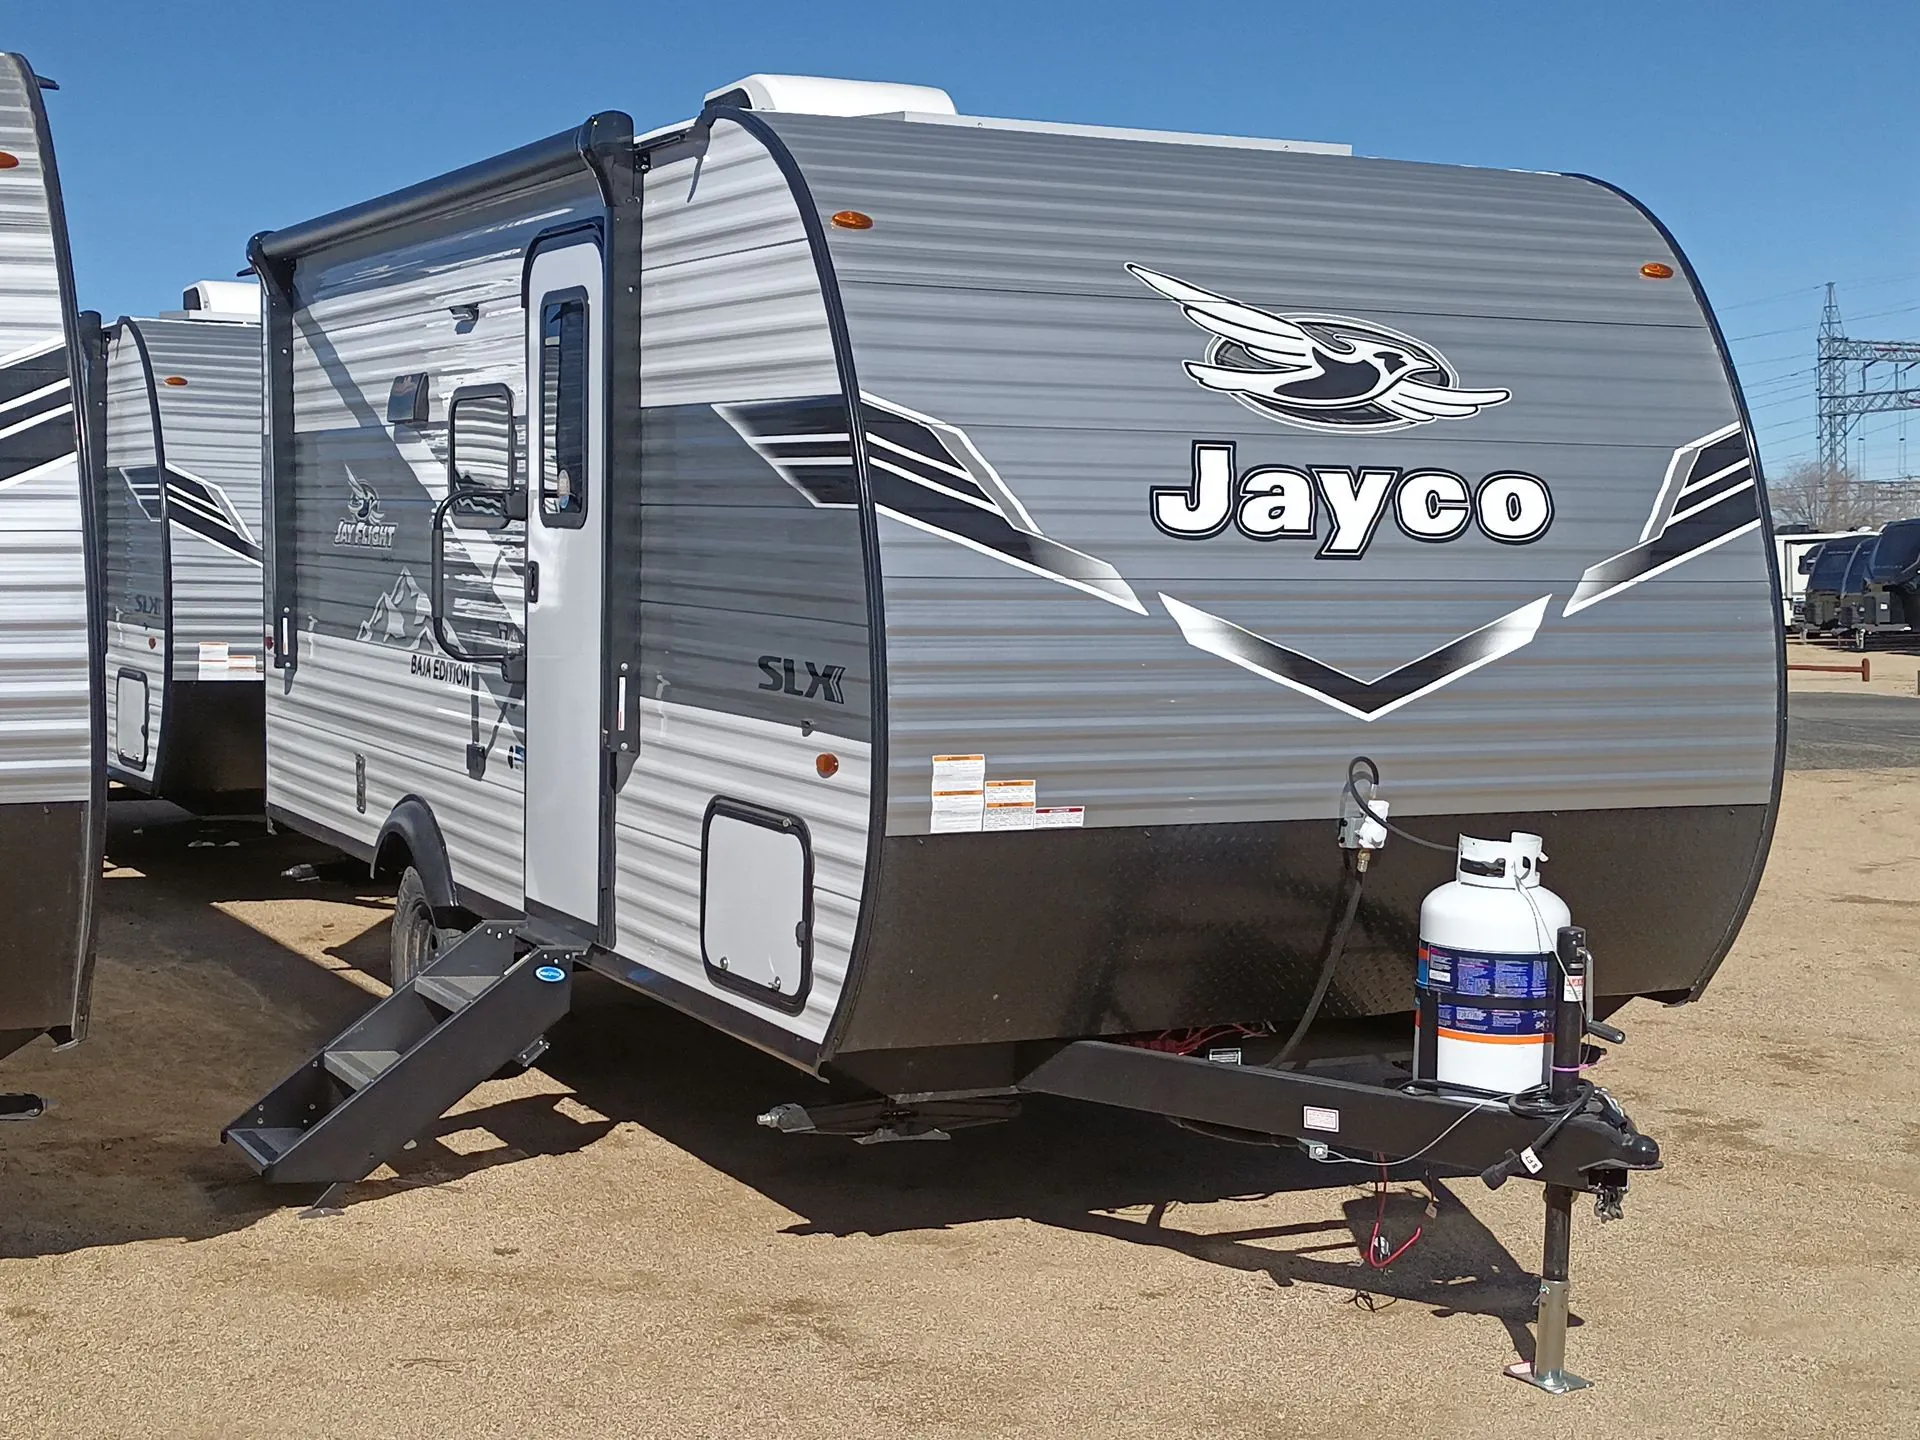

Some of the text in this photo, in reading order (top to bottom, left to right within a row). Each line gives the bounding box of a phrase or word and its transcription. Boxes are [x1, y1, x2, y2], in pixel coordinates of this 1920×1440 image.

[1150, 440, 1555, 560] Jayco
[334, 519, 397, 549] JAY FLIGHT
[135, 594, 160, 615] SLX
[411, 654, 470, 687] BAJA EDITION
[758, 655, 846, 705] SLX
